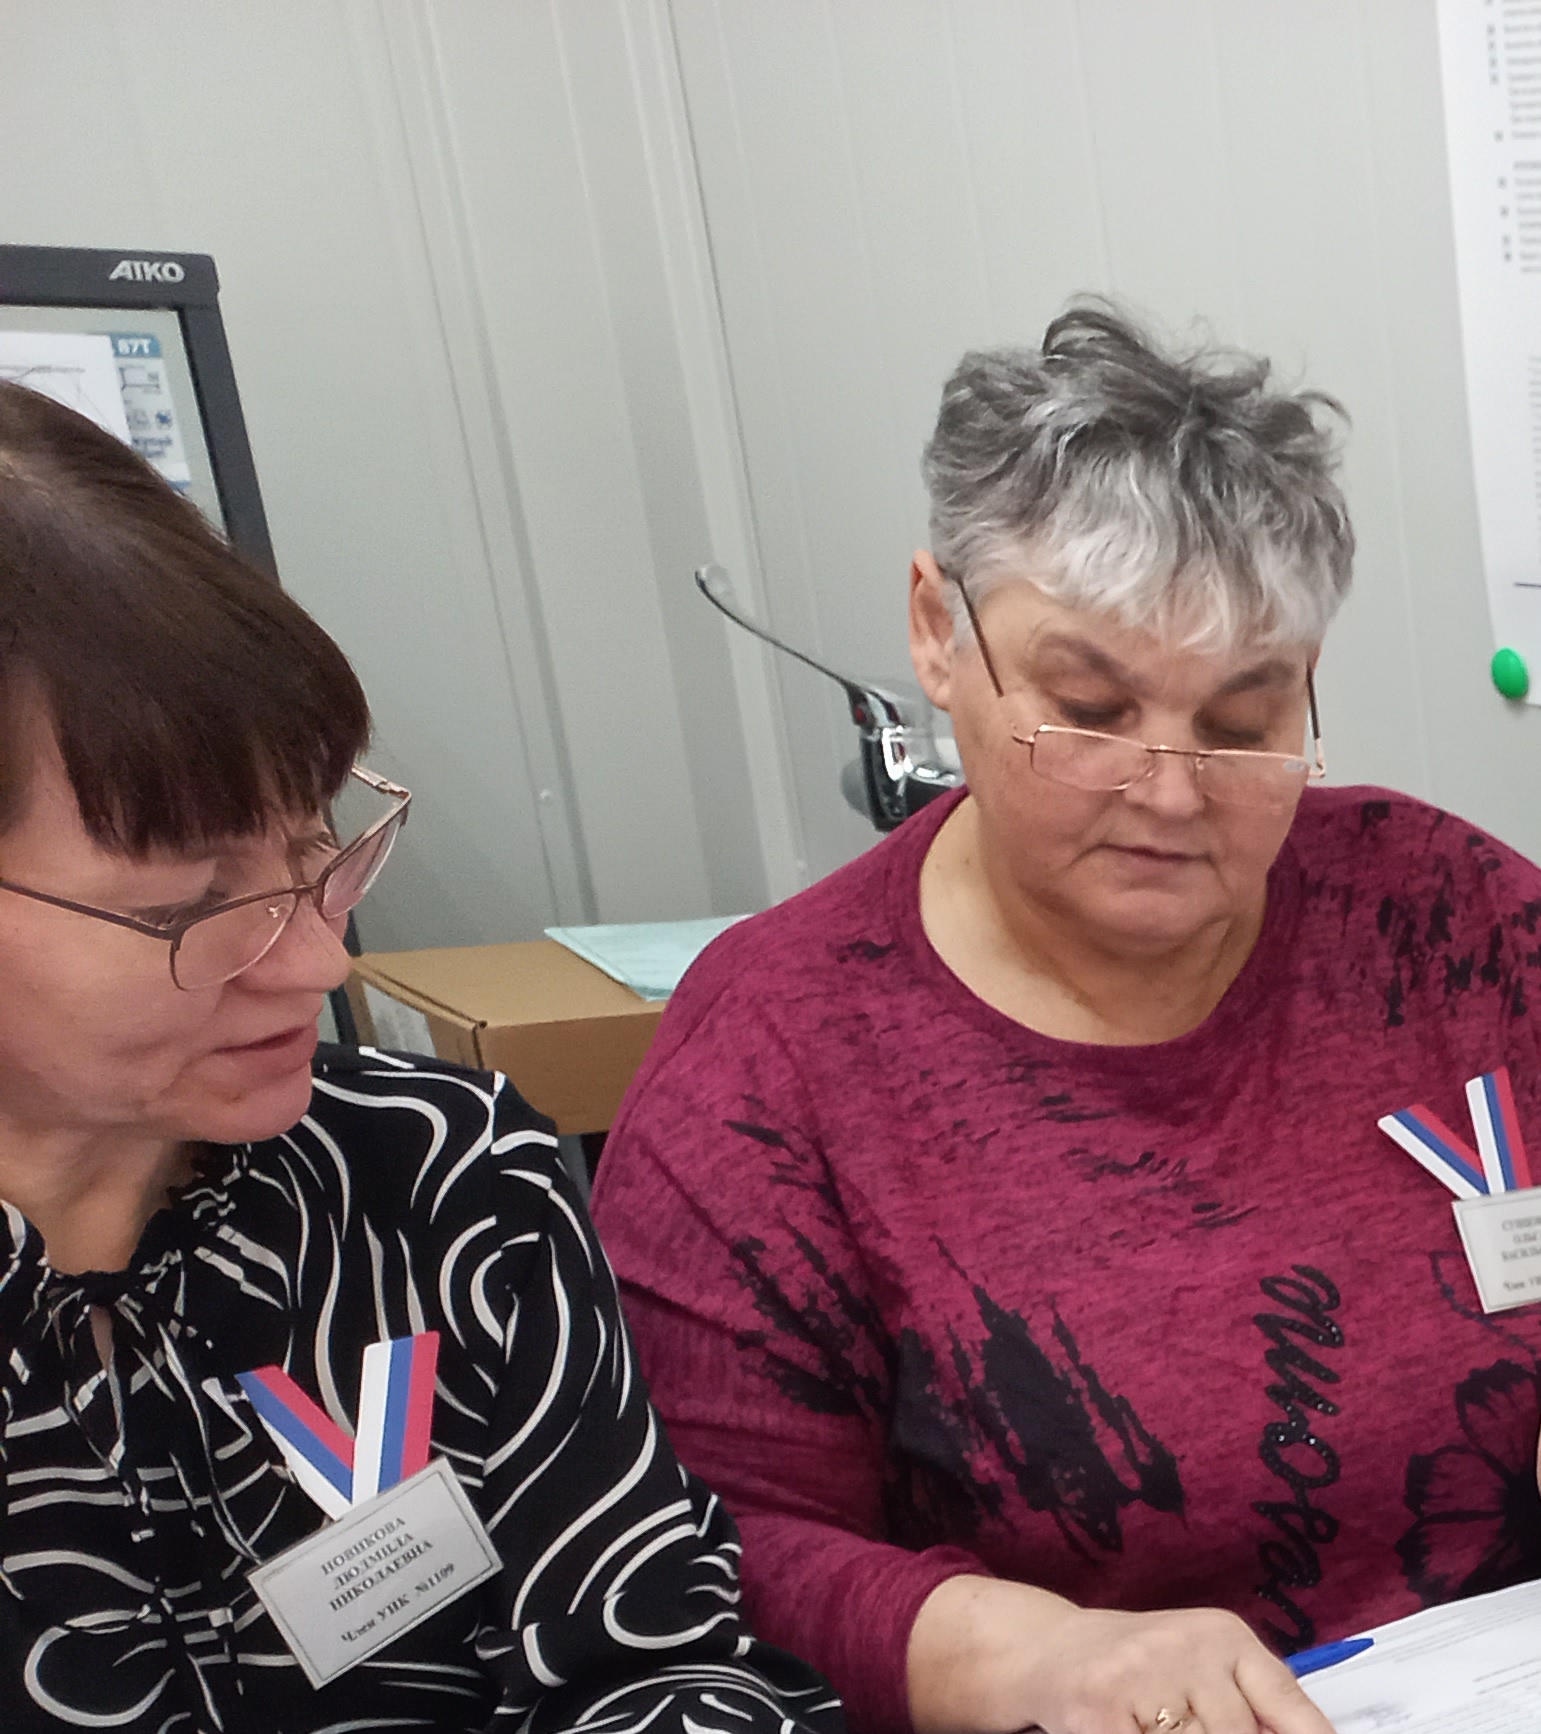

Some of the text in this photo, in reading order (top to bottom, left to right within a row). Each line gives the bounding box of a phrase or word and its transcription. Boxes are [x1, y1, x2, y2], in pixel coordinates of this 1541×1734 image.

[108, 260, 185, 283] AIKO
[341, 1617, 377, 1643] Член
[377, 1593, 410, 1621] УИК
